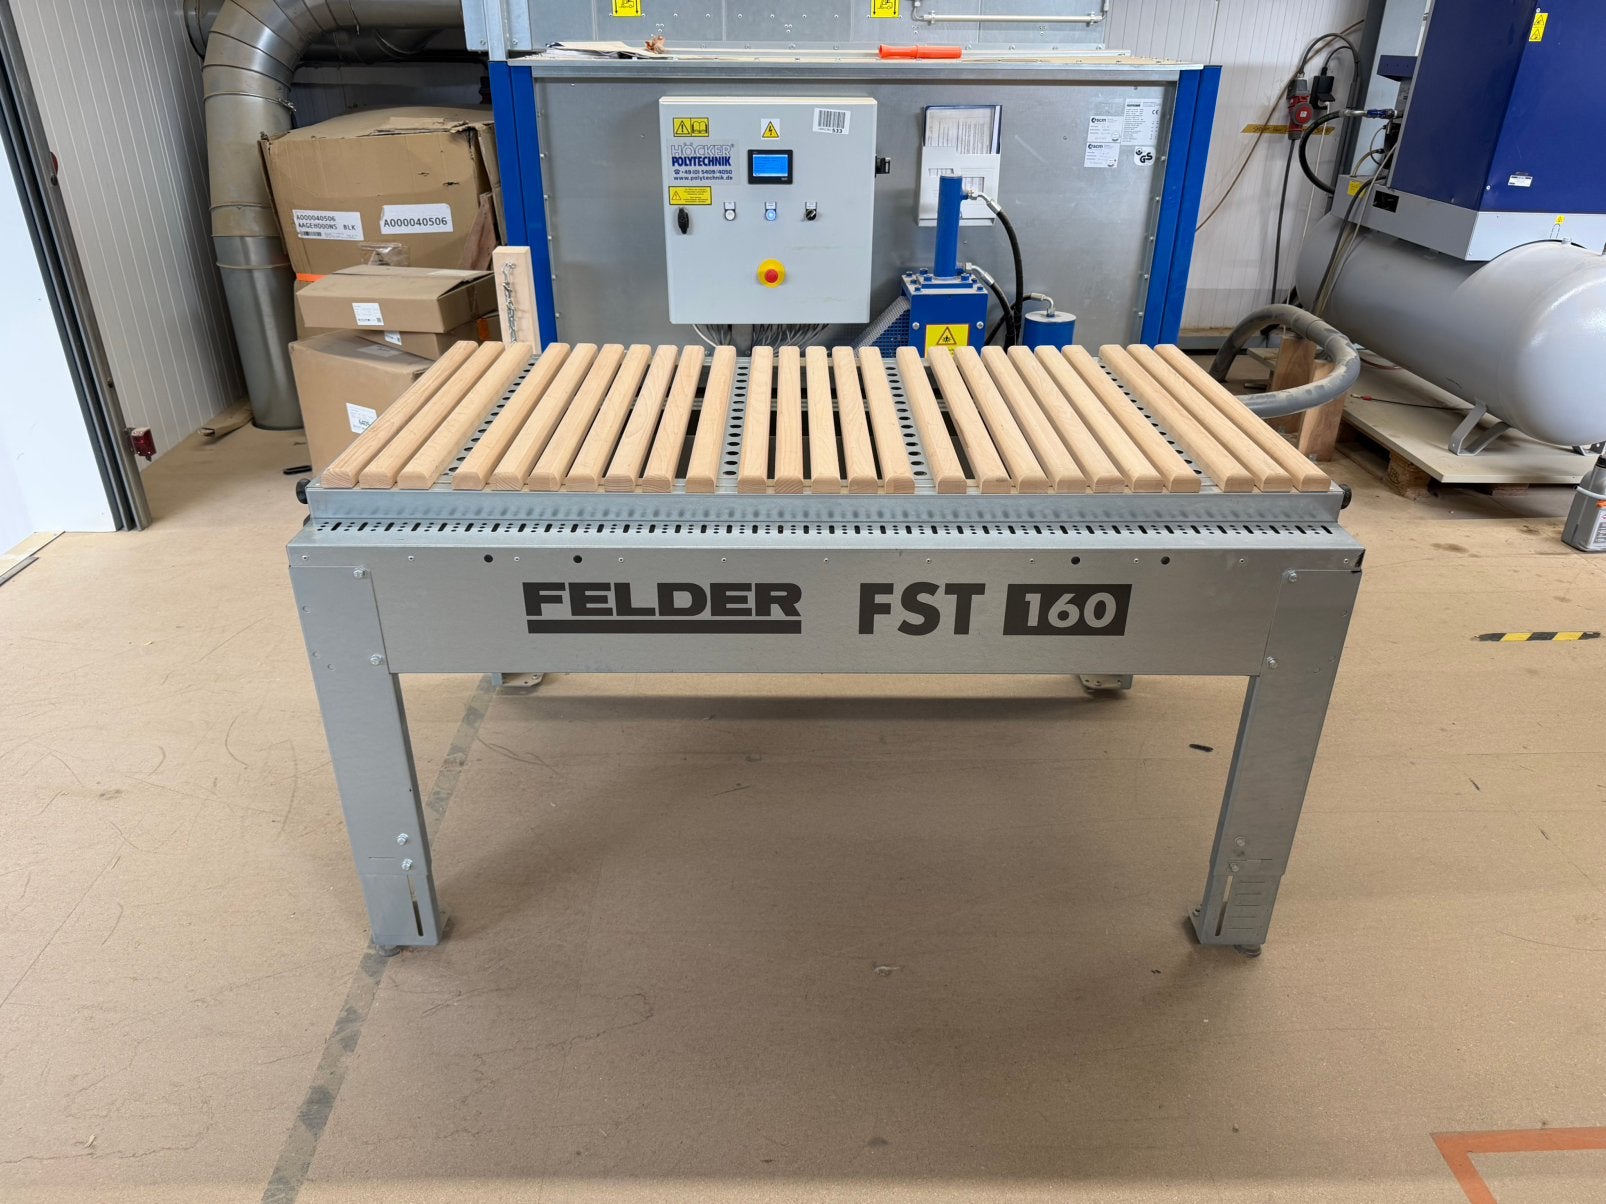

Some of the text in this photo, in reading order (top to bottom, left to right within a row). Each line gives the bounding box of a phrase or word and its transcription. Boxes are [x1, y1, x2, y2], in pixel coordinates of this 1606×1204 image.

[672, 156, 731, 167] POLYTECHNIK
[296, 214, 336, 222] A000040506
[383, 216, 448, 228] A000040506
[522, 582, 802, 617] FELDER
[857, 581, 1117, 636] FST 160
